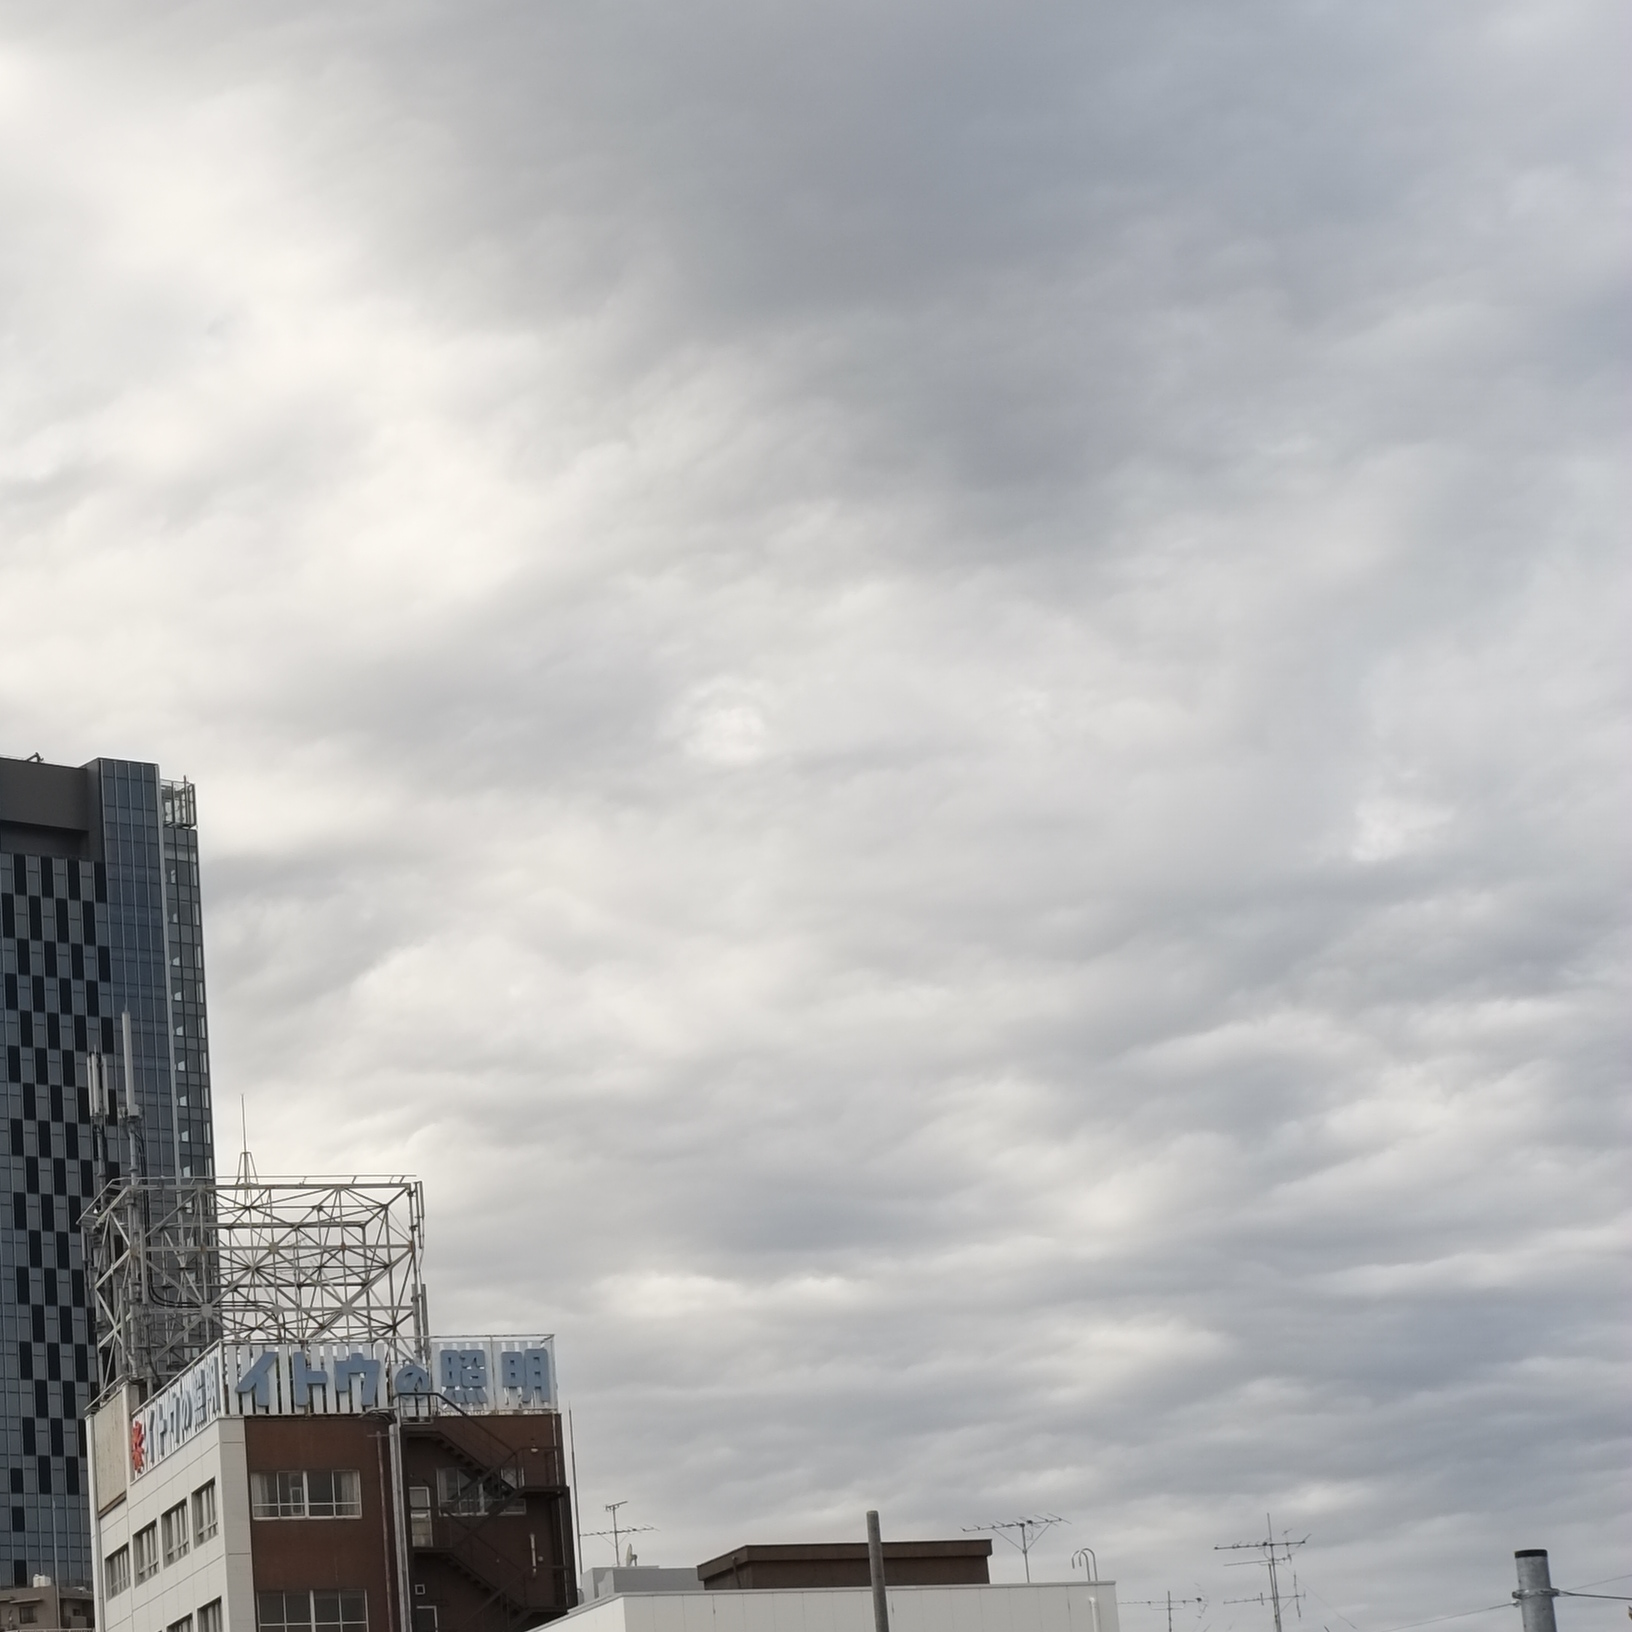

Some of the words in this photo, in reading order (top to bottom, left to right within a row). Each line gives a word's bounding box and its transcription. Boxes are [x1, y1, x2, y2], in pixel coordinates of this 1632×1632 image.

[235, 1348, 550, 1408] イトウの照明
